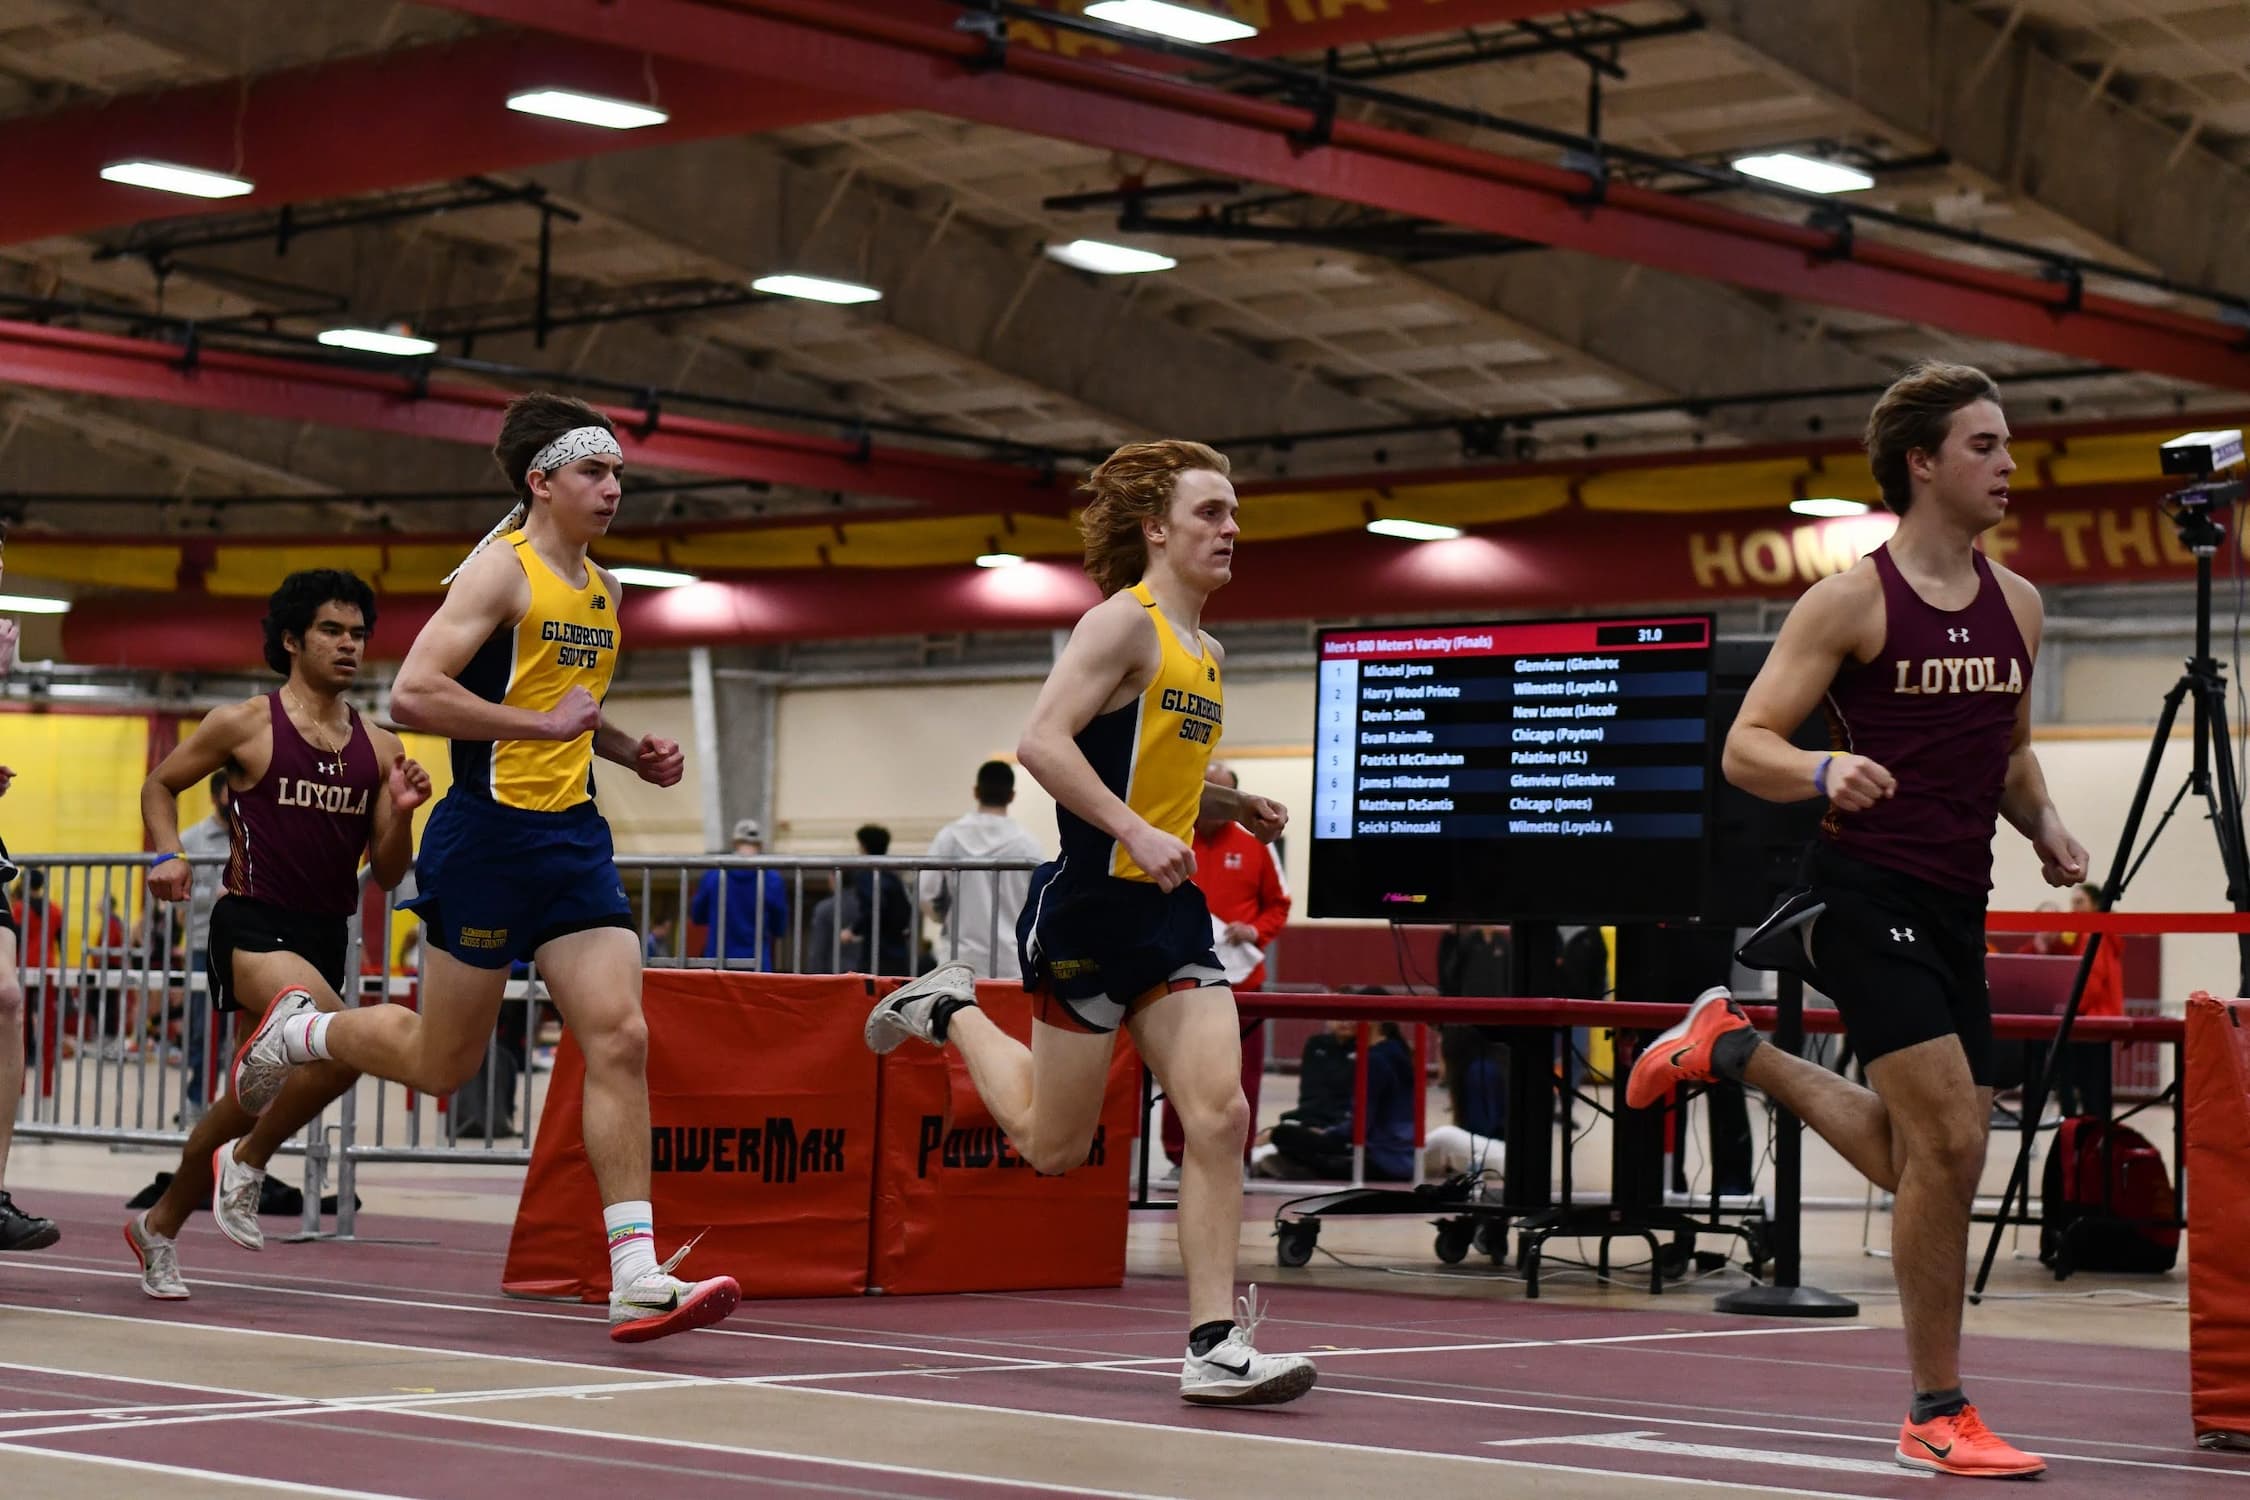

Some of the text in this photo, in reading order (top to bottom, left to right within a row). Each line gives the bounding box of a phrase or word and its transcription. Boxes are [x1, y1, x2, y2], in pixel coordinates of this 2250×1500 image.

[1689, 523, 1866, 587] HOM
[541, 621, 614, 650] GLENBROOK
[1638, 628, 1663, 642] 31.0
[1324, 635, 1493, 653] Men's 800 Meters Varsity (Finals)
[557, 646, 598, 669] SOUTH
[1514, 659, 1565, 672] Glenview
[1363, 663, 1434, 678] Michael Jerva
[1894, 657, 2022, 694] LOYOLA
[1362, 685, 1461, 702] Harry Wood Prince
[1513, 681, 1565, 695] Wilmette
[1565, 680, 1606, 697] (Loyola
[1362, 708, 1425, 722] Devin Smith
[1513, 706, 1539, 718] New
[1540, 705, 1573, 718] Lenox
[1179, 718, 1213, 745] SOUTH
[1361, 732, 1387, 745] Evan
[1512, 727, 1604, 744] Chicago (Payton)
[1360, 754, 1397, 767] Patrick
[1511, 751, 1588, 765] Palatine (H.S.)
[1359, 776, 1391, 791] James
[1510, 774, 1561, 787] Glenview
[278, 777, 369, 815] LOYOLA
[1359, 798, 1454, 811] Matthew DeSantis
[1509, 797, 1593, 813] Chicago (Jones)
[1358, 820, 1441, 833] Seichi Shinozaki
[1509, 820, 1560, 833] Wilmette
[1561, 820, 1602, 836] (Loyola
[651, 1117, 845, 1183] OWERMAX
